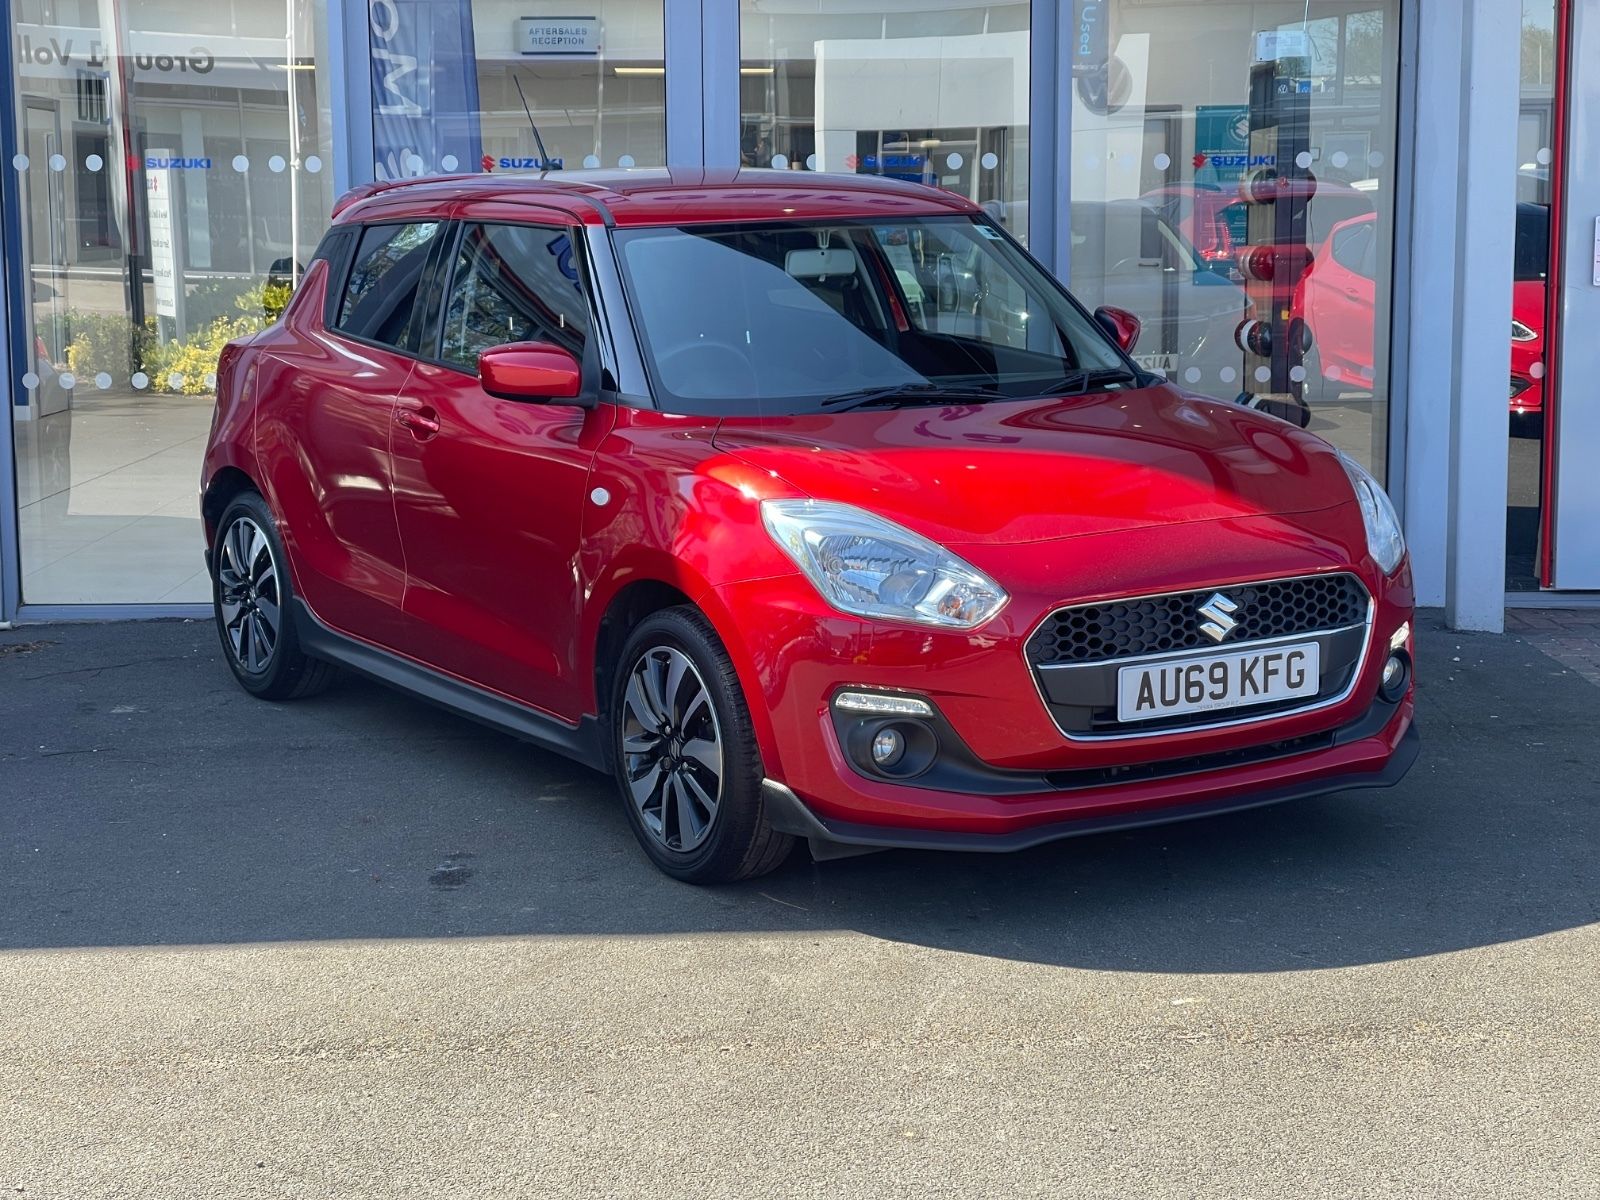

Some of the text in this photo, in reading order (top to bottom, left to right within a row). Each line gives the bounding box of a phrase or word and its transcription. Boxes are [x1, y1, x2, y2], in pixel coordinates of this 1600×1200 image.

[529, 27, 588, 35] AFTERSALES
[1080, 6, 1097, 55] Used
[531, 37, 585, 45] RECEPTION
[146, 157, 211, 169] SUZUKI
[1211, 155, 1275, 167] SUZUKI
[1135, 650, 1305, 711] AU69 KFG
